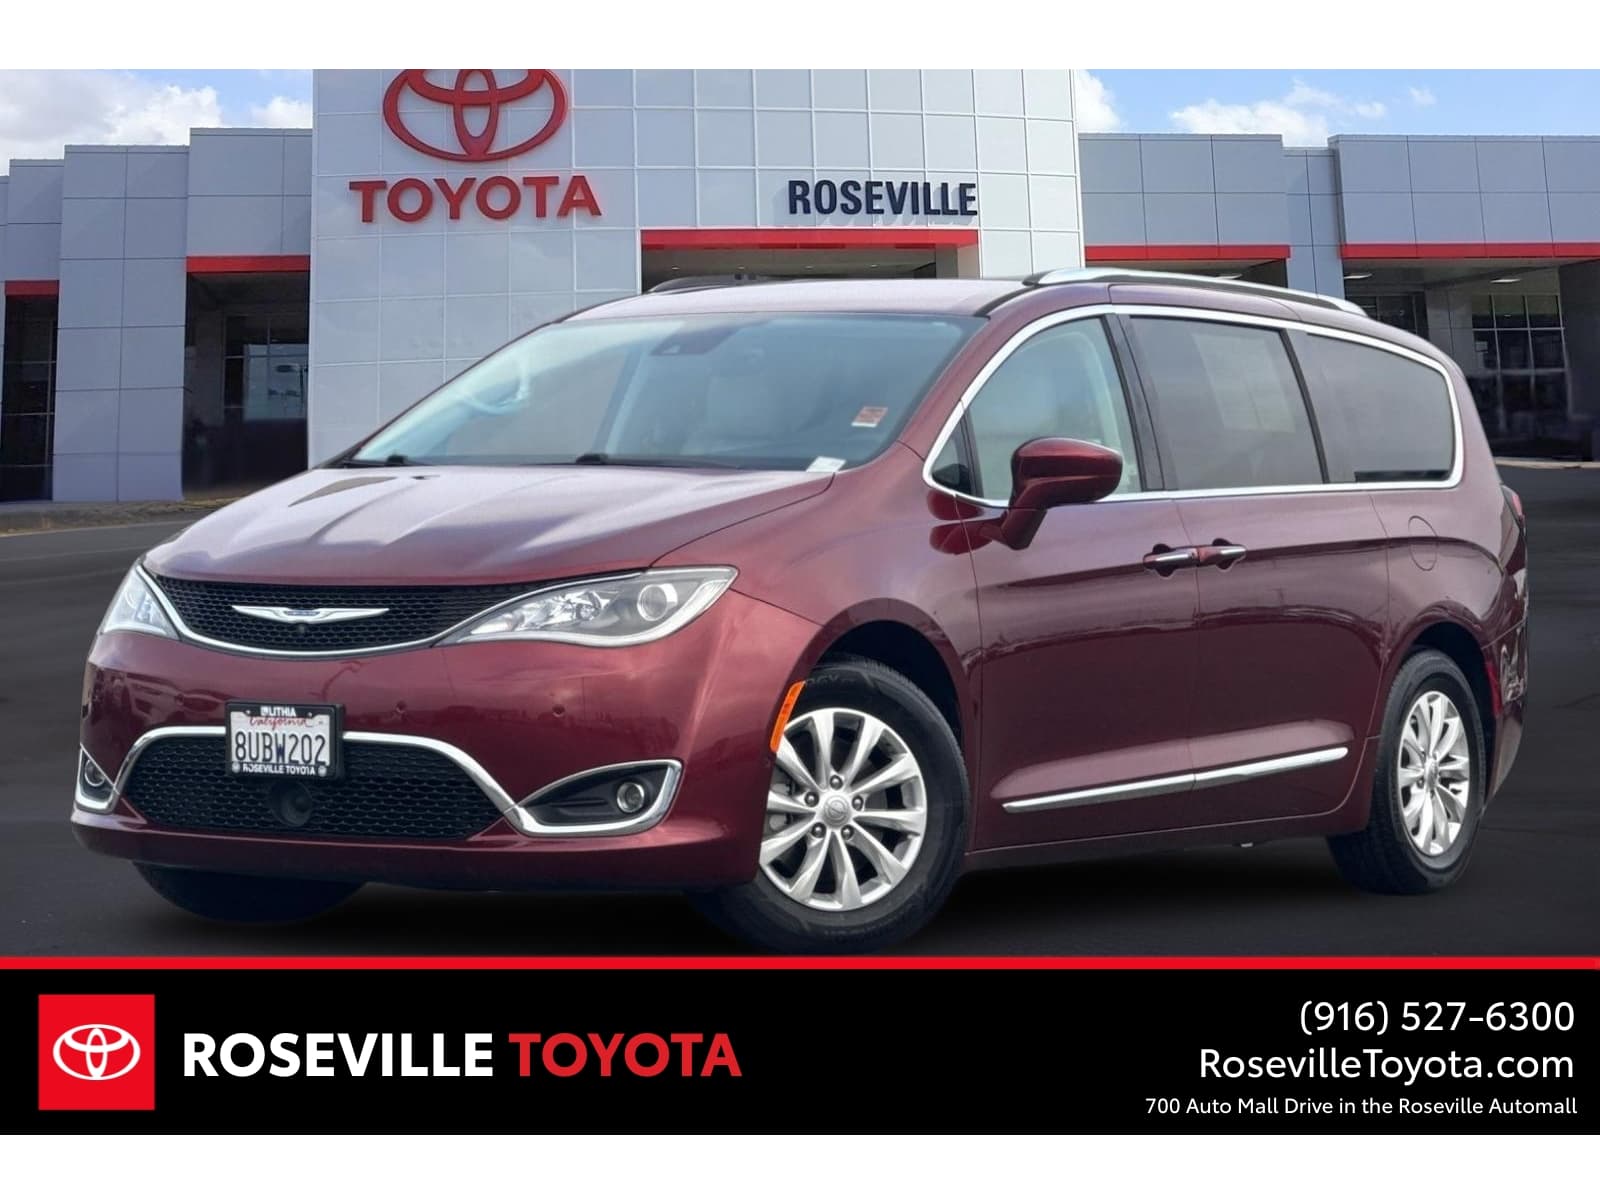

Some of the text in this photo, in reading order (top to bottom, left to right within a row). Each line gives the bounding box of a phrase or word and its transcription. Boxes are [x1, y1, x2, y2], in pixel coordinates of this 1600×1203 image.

[349, 175, 602, 223] TOYOTA
[788, 180, 978, 216] ROSEVILLE
[269, 706, 297, 717] LITHIA
[235, 731, 326, 764] 8UBW202
[243, 763, 316, 775] ROSEVILLE TOYOTA
